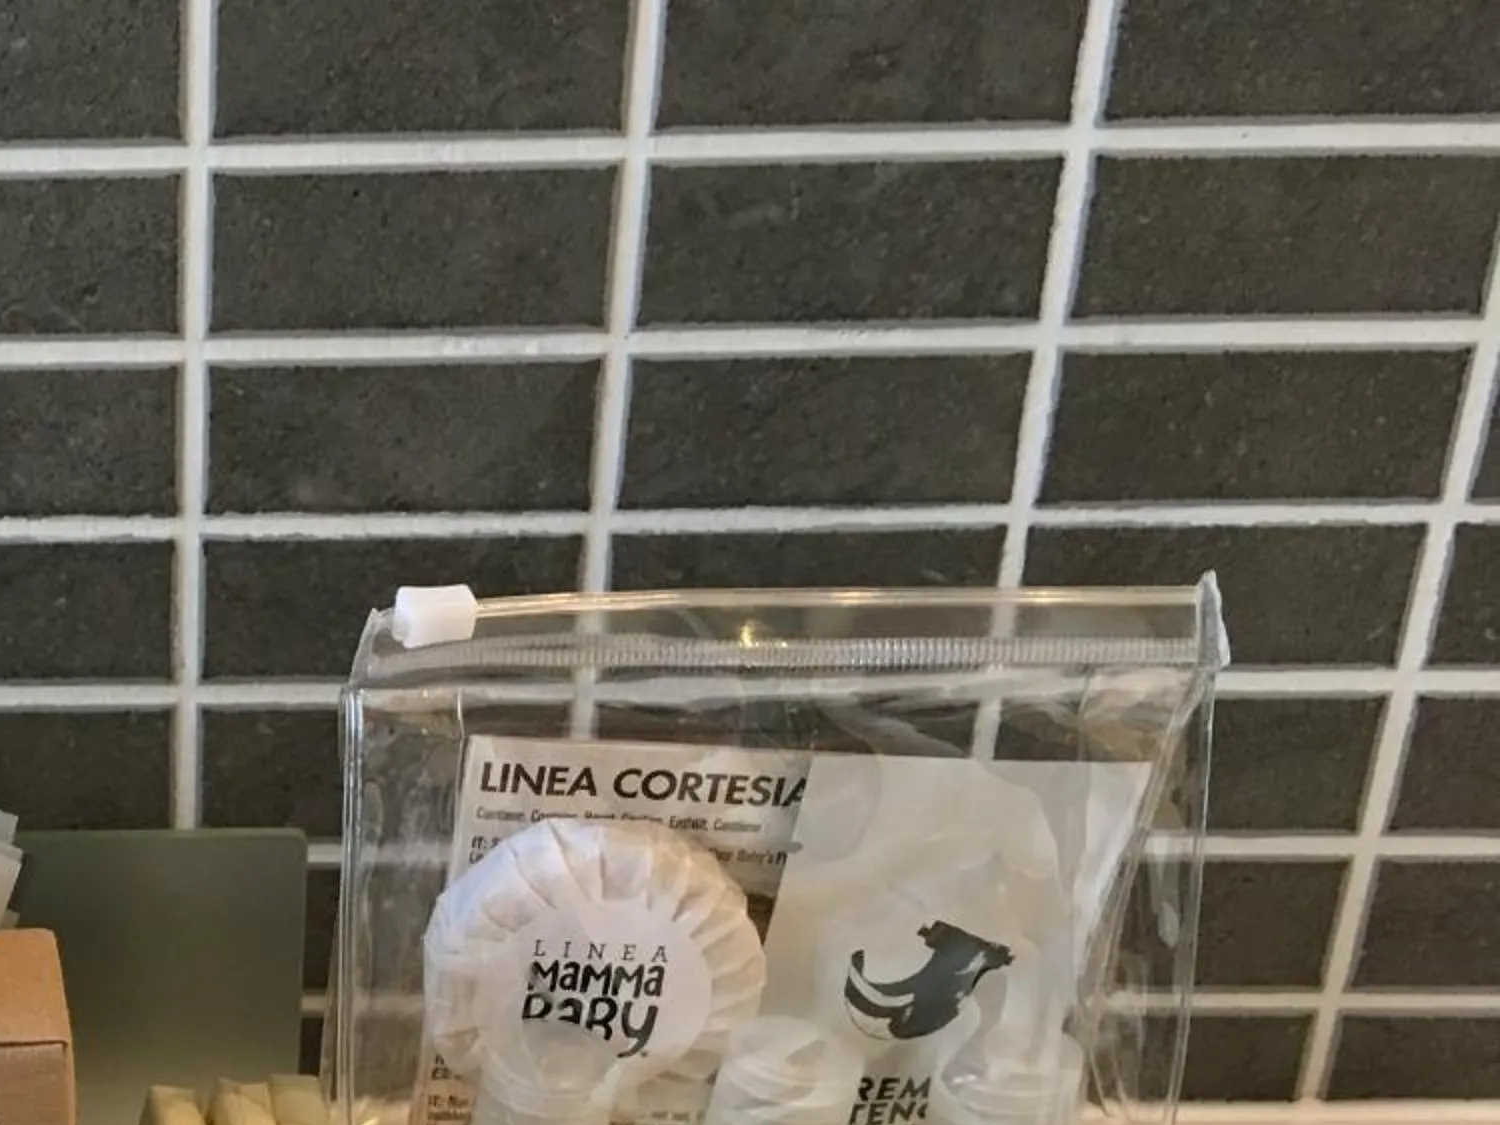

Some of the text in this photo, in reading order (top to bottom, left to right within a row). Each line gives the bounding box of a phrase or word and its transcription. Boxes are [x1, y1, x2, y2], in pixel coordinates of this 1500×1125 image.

[481, 762, 806, 808] LINEA CORTESIA
[534, 938, 668, 963] LINEA
[857, 1075, 931, 1101] REM
